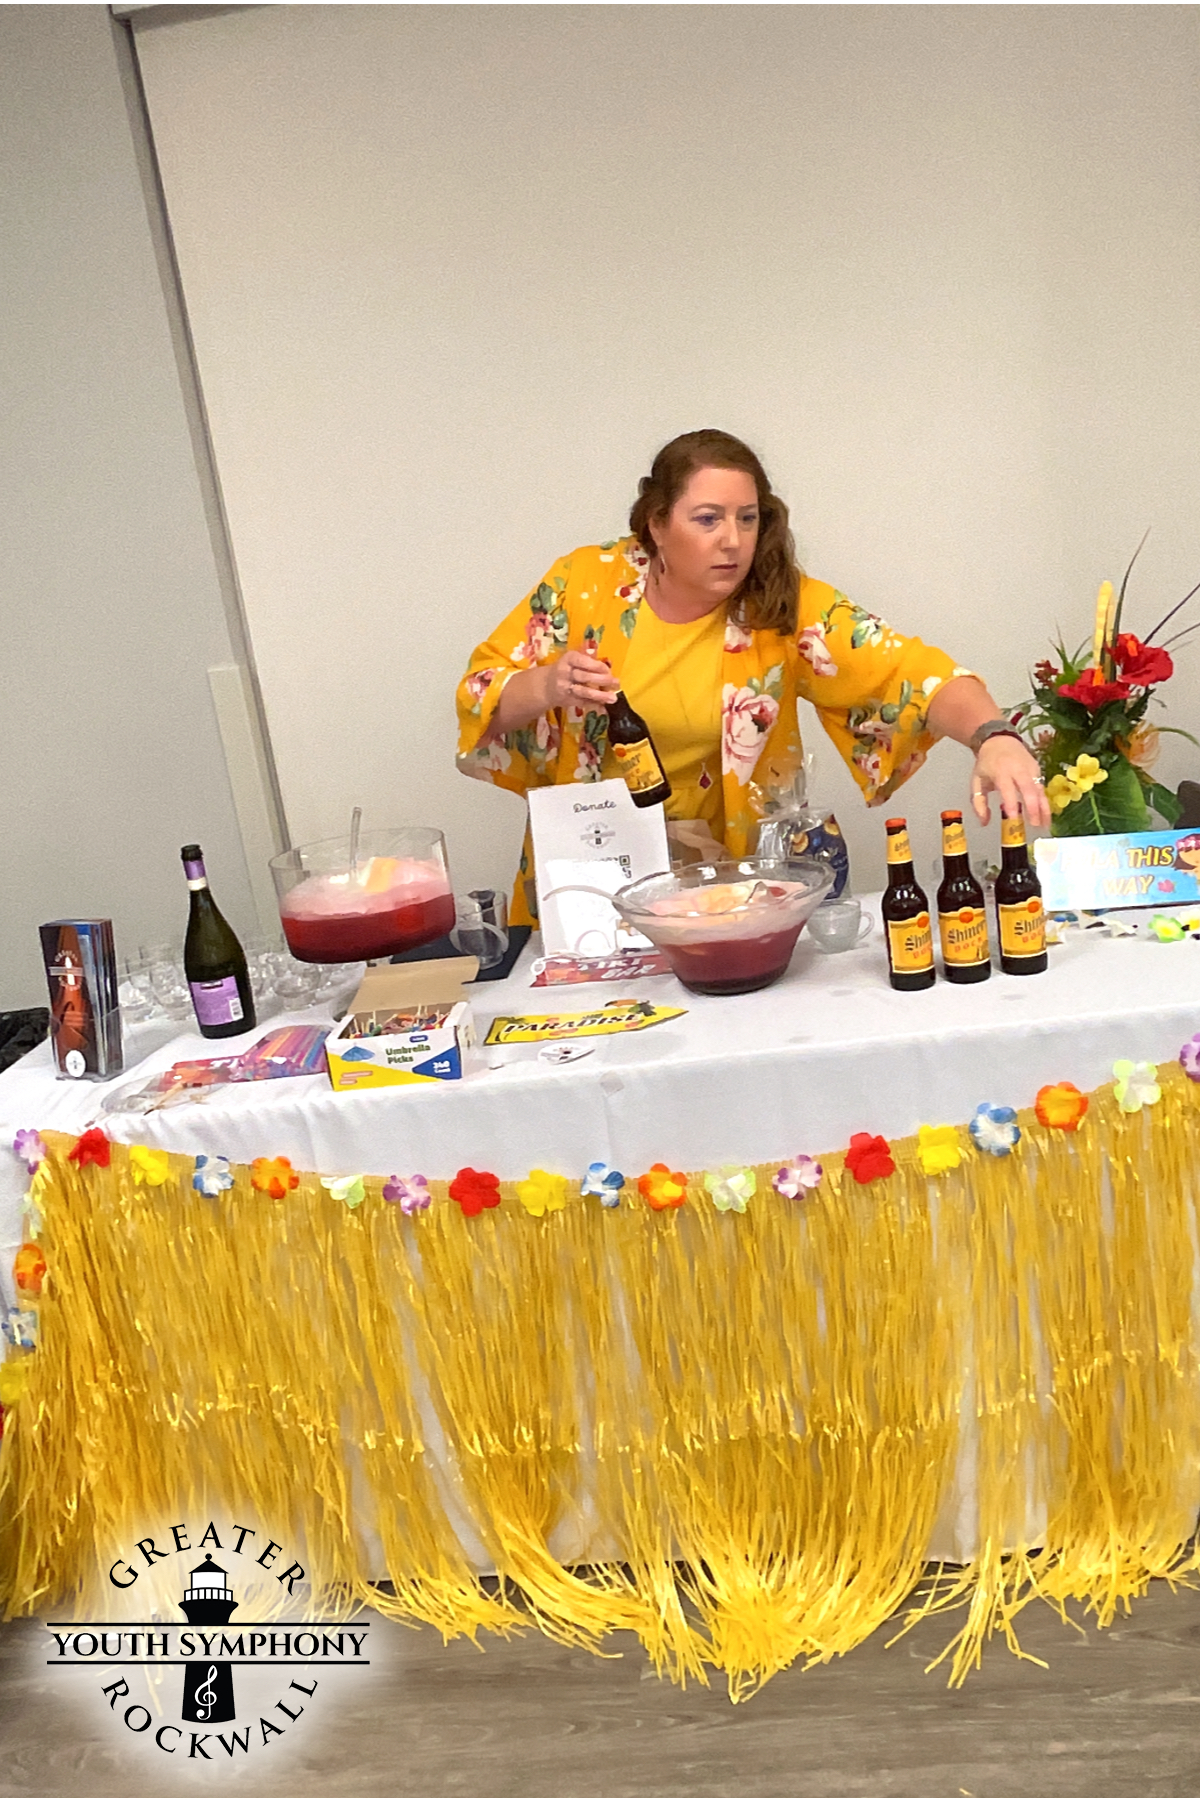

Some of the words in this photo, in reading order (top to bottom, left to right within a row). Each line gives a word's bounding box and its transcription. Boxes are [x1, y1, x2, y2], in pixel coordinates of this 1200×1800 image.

[573, 800, 617, 813] Donate
[1126, 846, 1174, 868] THIS
[1102, 875, 1154, 896] WAY
[504, 1014, 640, 1033] PARADISE
[385, 1043, 431, 1056] Umbrella
[387, 1055, 414, 1065] Picks
